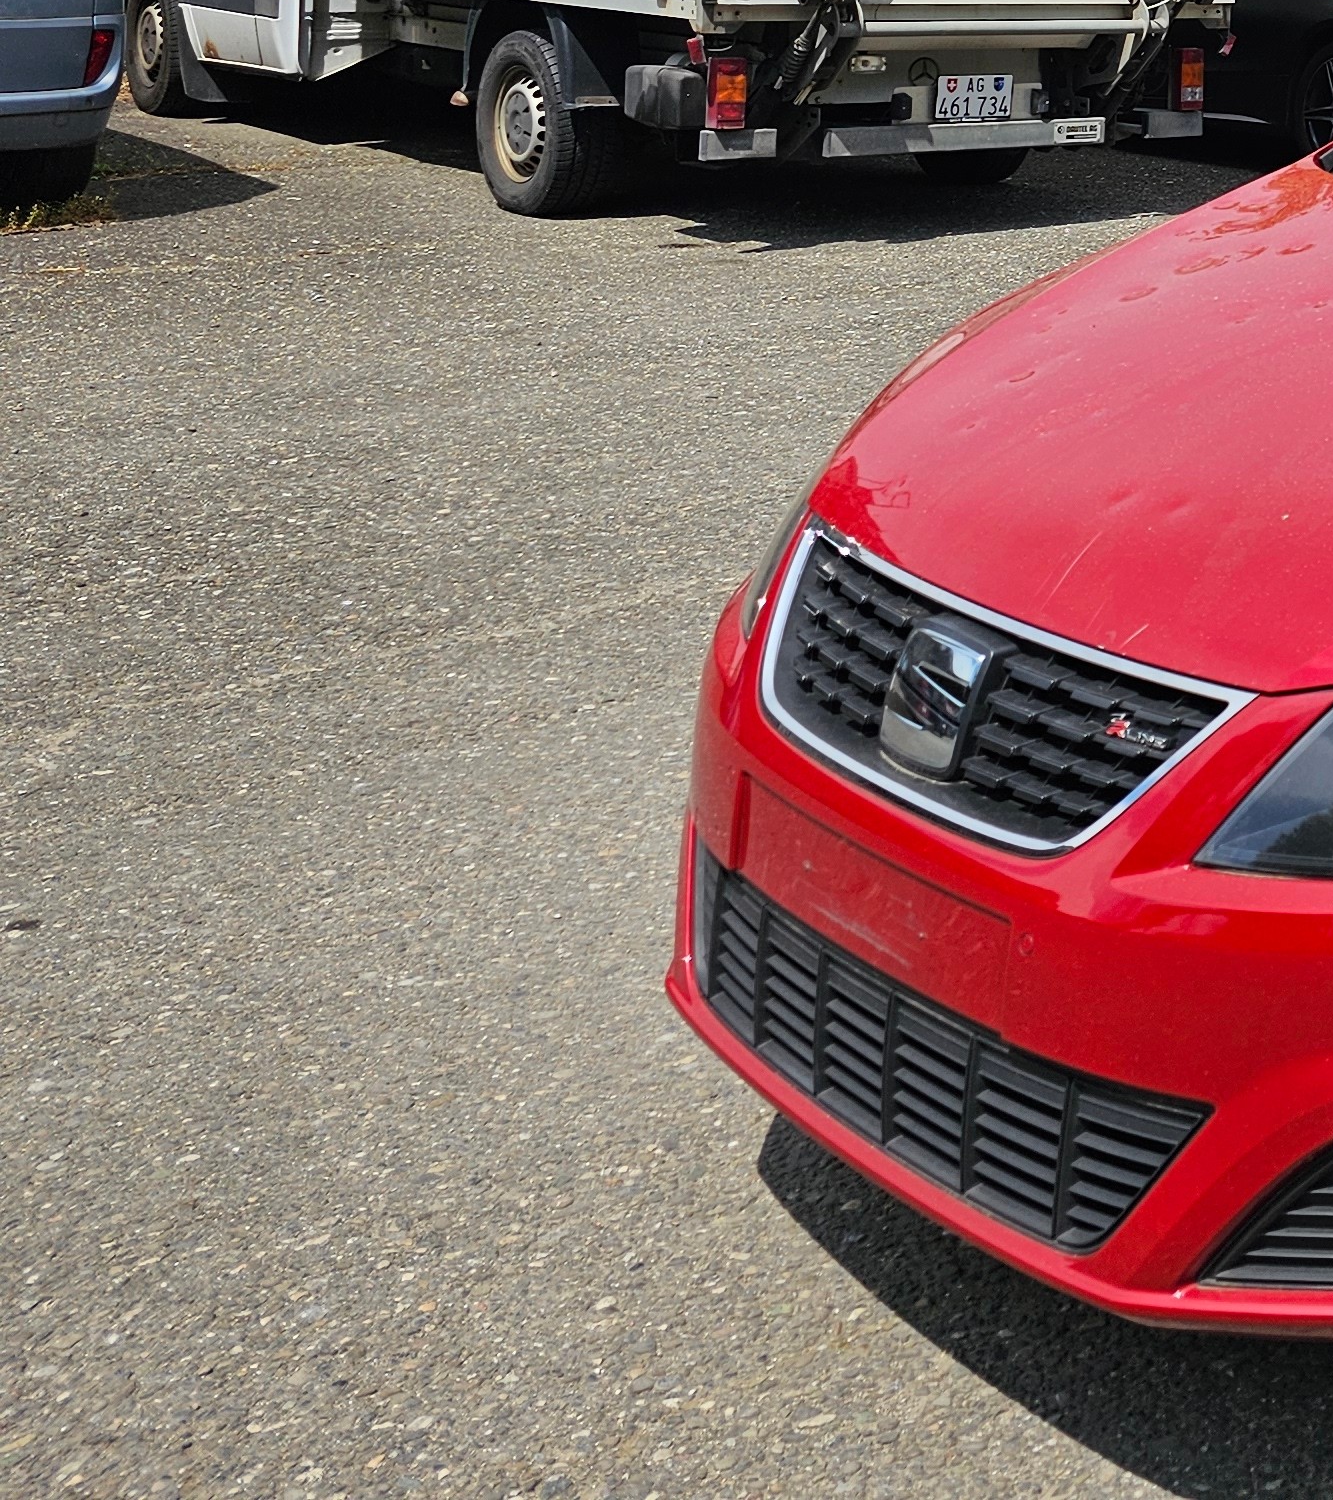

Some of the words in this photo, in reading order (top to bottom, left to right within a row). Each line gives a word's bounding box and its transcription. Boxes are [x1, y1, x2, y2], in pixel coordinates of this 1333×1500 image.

[966, 77, 985, 92] AG
[938, 97, 970, 117] 461
[977, 96, 1009, 116] 734
